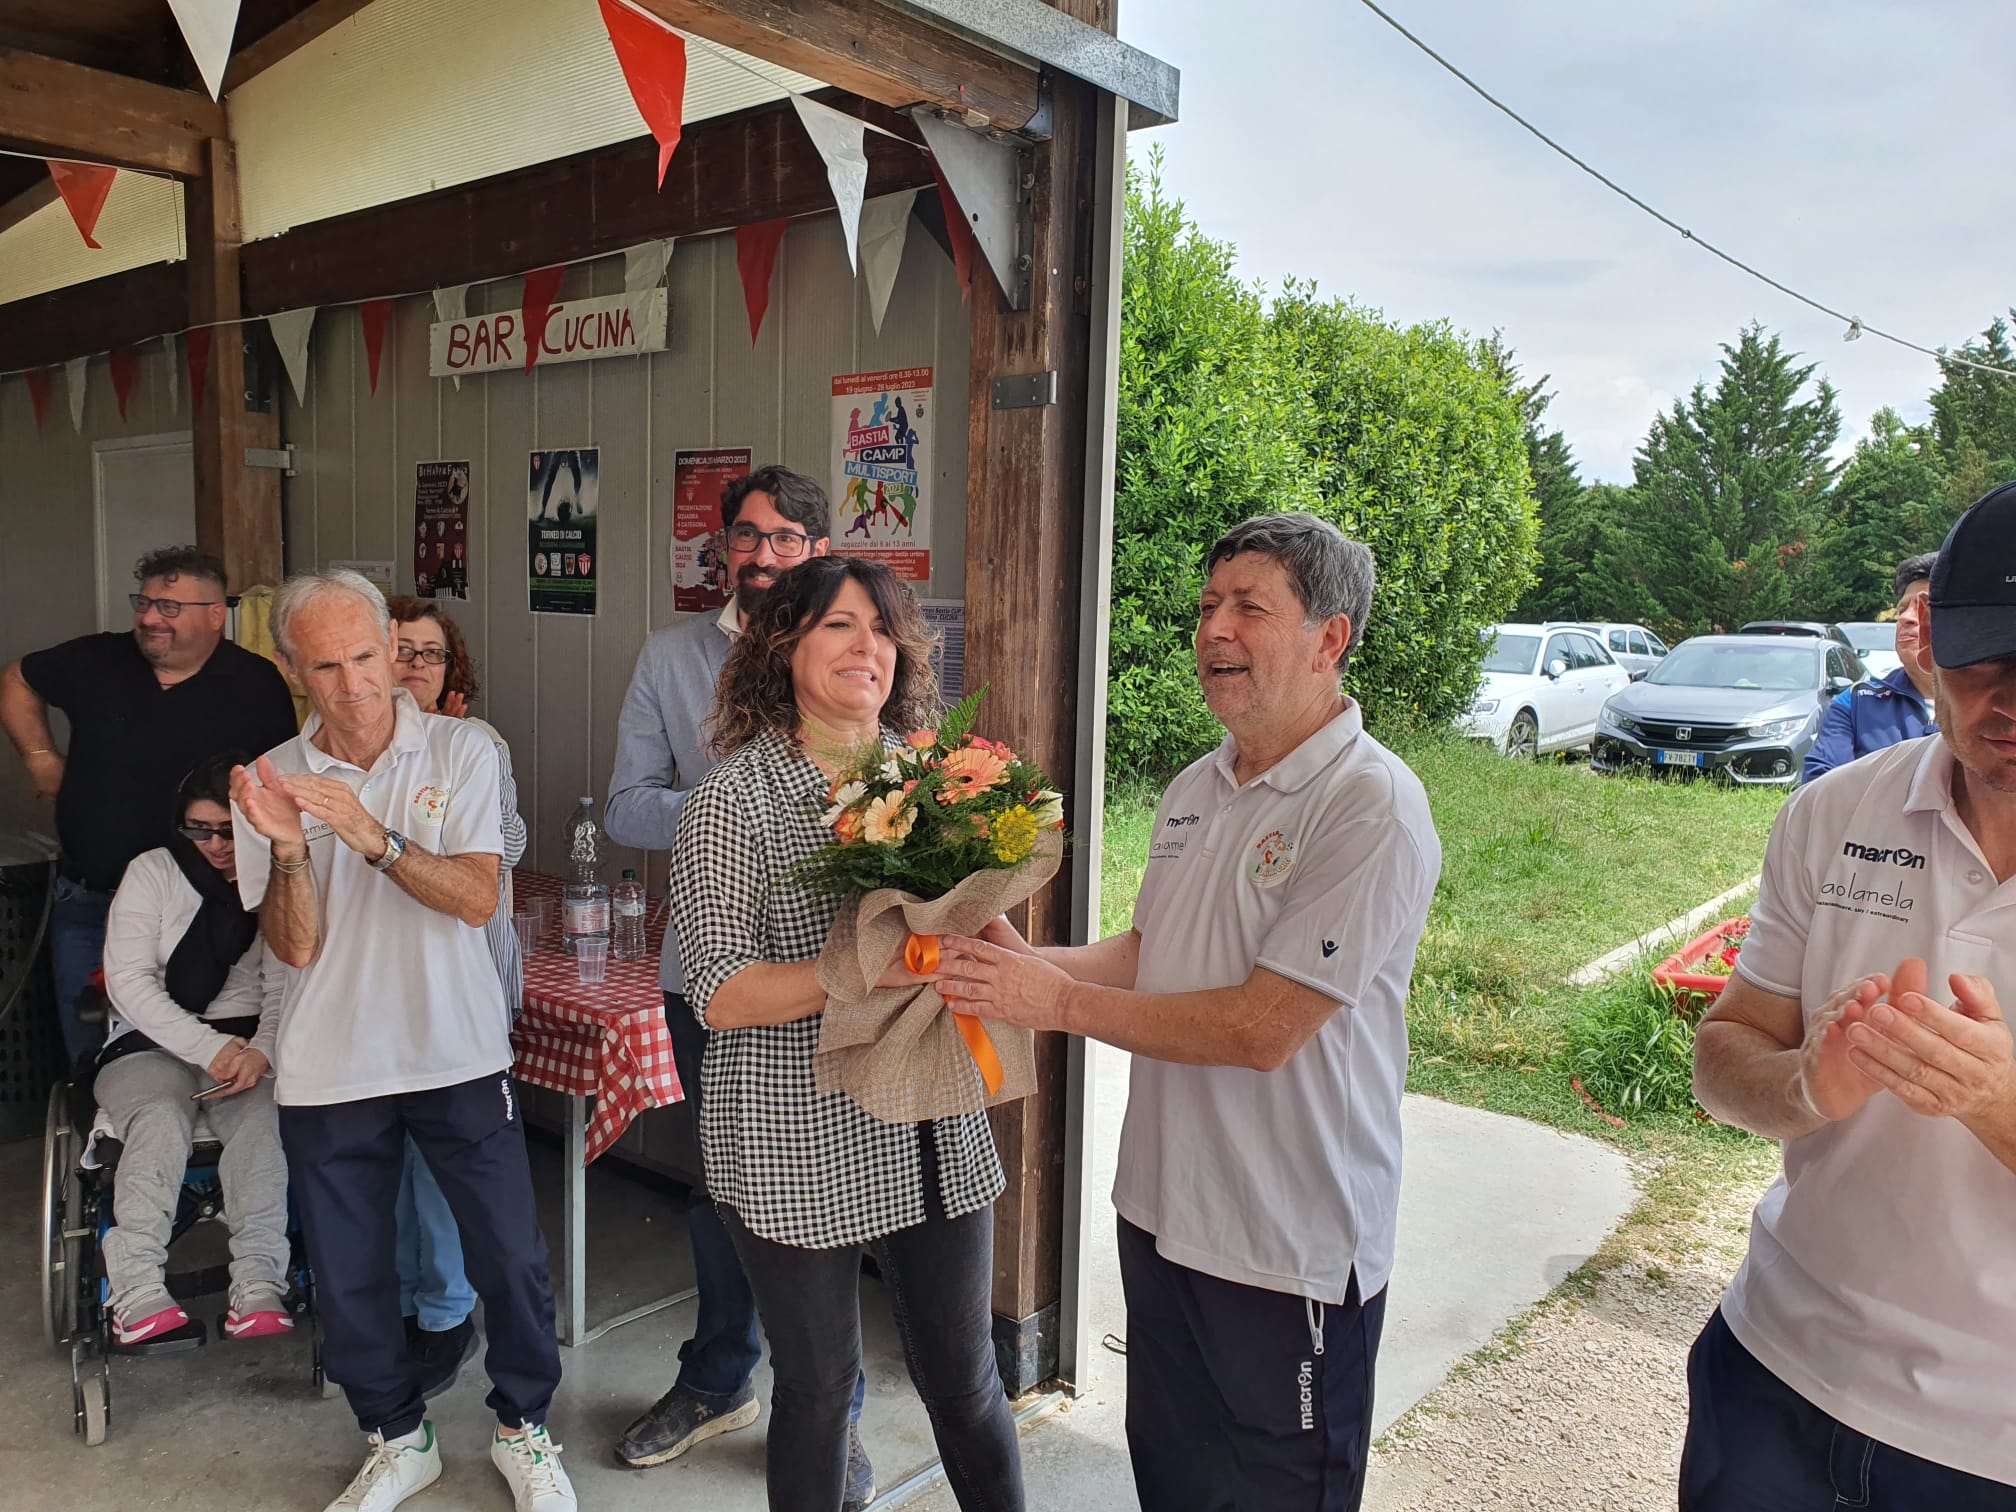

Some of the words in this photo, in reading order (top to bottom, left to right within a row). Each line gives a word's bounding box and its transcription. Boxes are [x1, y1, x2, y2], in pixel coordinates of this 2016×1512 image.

[446, 315, 515, 368] BAR
[541, 305, 636, 355] CUCINA
[851, 429, 889, 447] BASTIA
[862, 447, 905, 461] CAMP
[847, 461, 917, 484] MULTISPORT
[1297, 1361, 1314, 1430] macron
